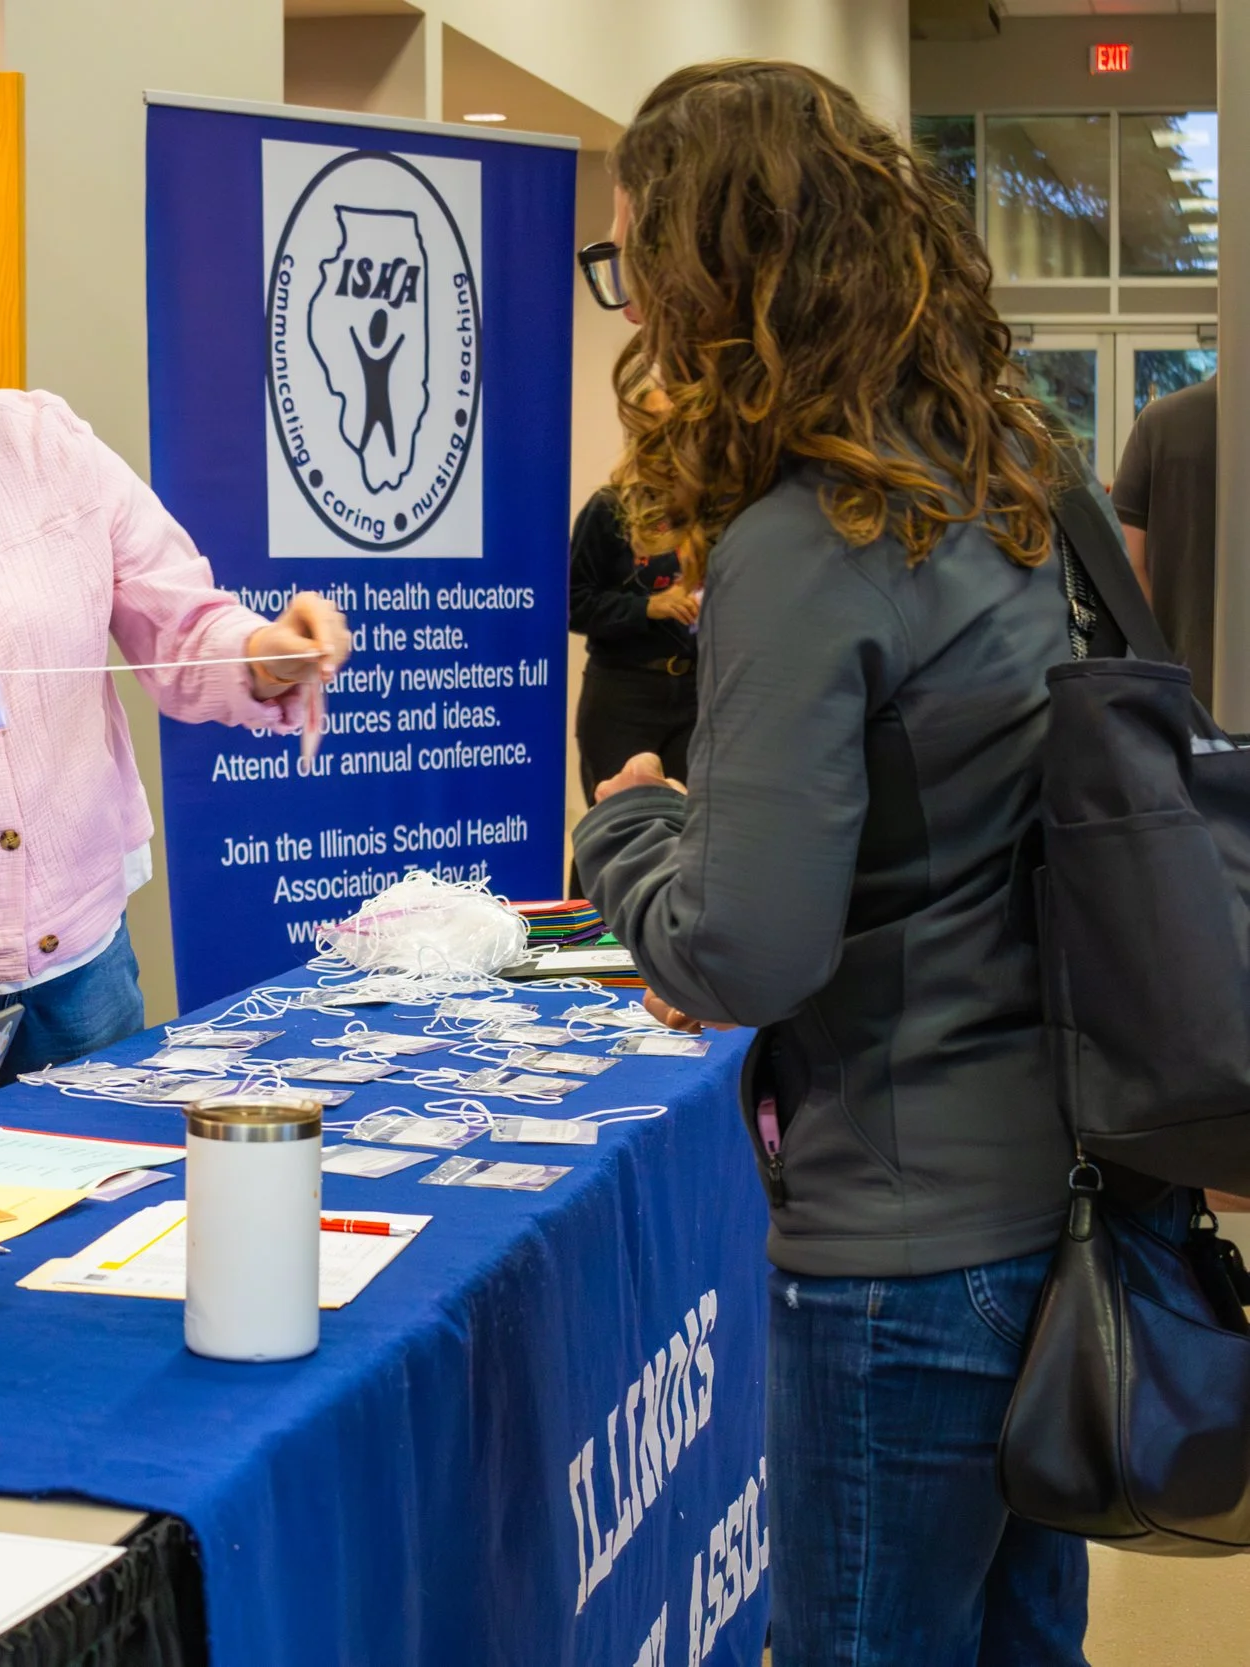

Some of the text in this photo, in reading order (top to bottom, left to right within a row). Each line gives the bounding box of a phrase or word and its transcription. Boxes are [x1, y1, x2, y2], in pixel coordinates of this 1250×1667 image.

[1097, 46, 1129, 71] EXIT
[334, 256, 422, 310] ISHA
[274, 254, 474, 539] communicating caring nursing teaching
[364, 582, 430, 611] health
[436, 582, 535, 610] educators
[372, 623, 407, 652] the
[413, 622, 469, 650] state.
[319, 658, 549, 699] arterly newsletters full
[397, 706, 438, 734] and
[442, 702, 502, 730] ideas.
[211, 740, 533, 783] Attend our annual conference.
[220, 814, 528, 867] Join the Illinois School Health
[273, 867, 398, 905] Association
[568, 1288, 719, 1617] ILLINOIS
